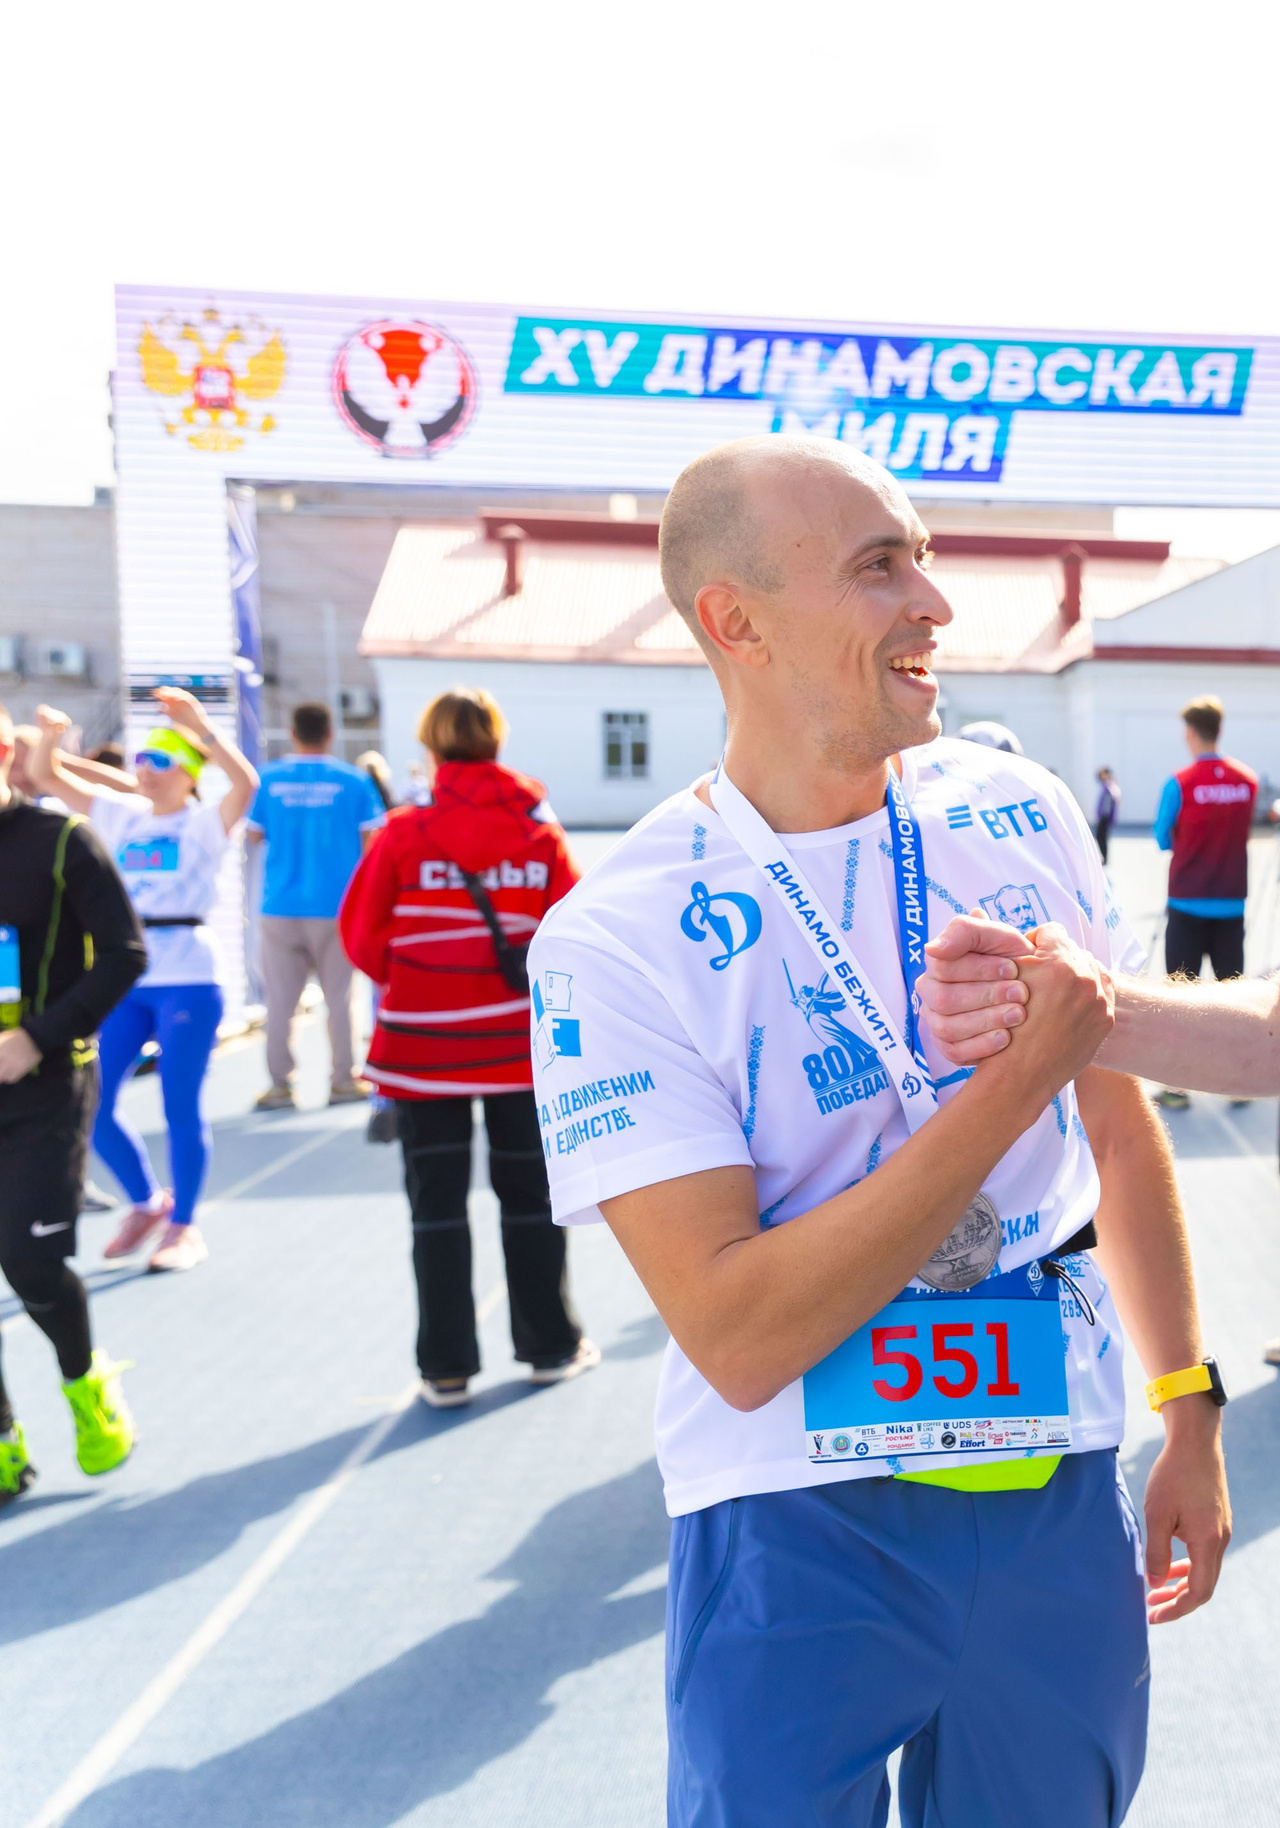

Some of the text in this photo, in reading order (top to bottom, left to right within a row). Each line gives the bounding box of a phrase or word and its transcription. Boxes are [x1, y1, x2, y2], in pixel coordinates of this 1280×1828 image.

[520, 326, 1238, 408] XV ДИНАМОВСКАЯ
[977, 798, 1048, 840] ВТБ
[763, 861, 897, 1052] ДИНАМО БЕЖИТ!
[907, 929, 922, 966] XV
[802, 1045, 850, 1091] 80
[559, 1070, 657, 1121] ДВИЖЕНИИ
[816, 1070, 890, 1116] ПОБЕДА!
[556, 1106, 637, 1156] ЕДИНСТВЕ
[871, 1322, 1020, 1402] 551
[861, 1428, 876, 1436] ВТБ
[886, 1424, 914, 1435] Nika
[952, 1421, 972, 1429] UDS
[960, 1439, 986, 1449] Effort
